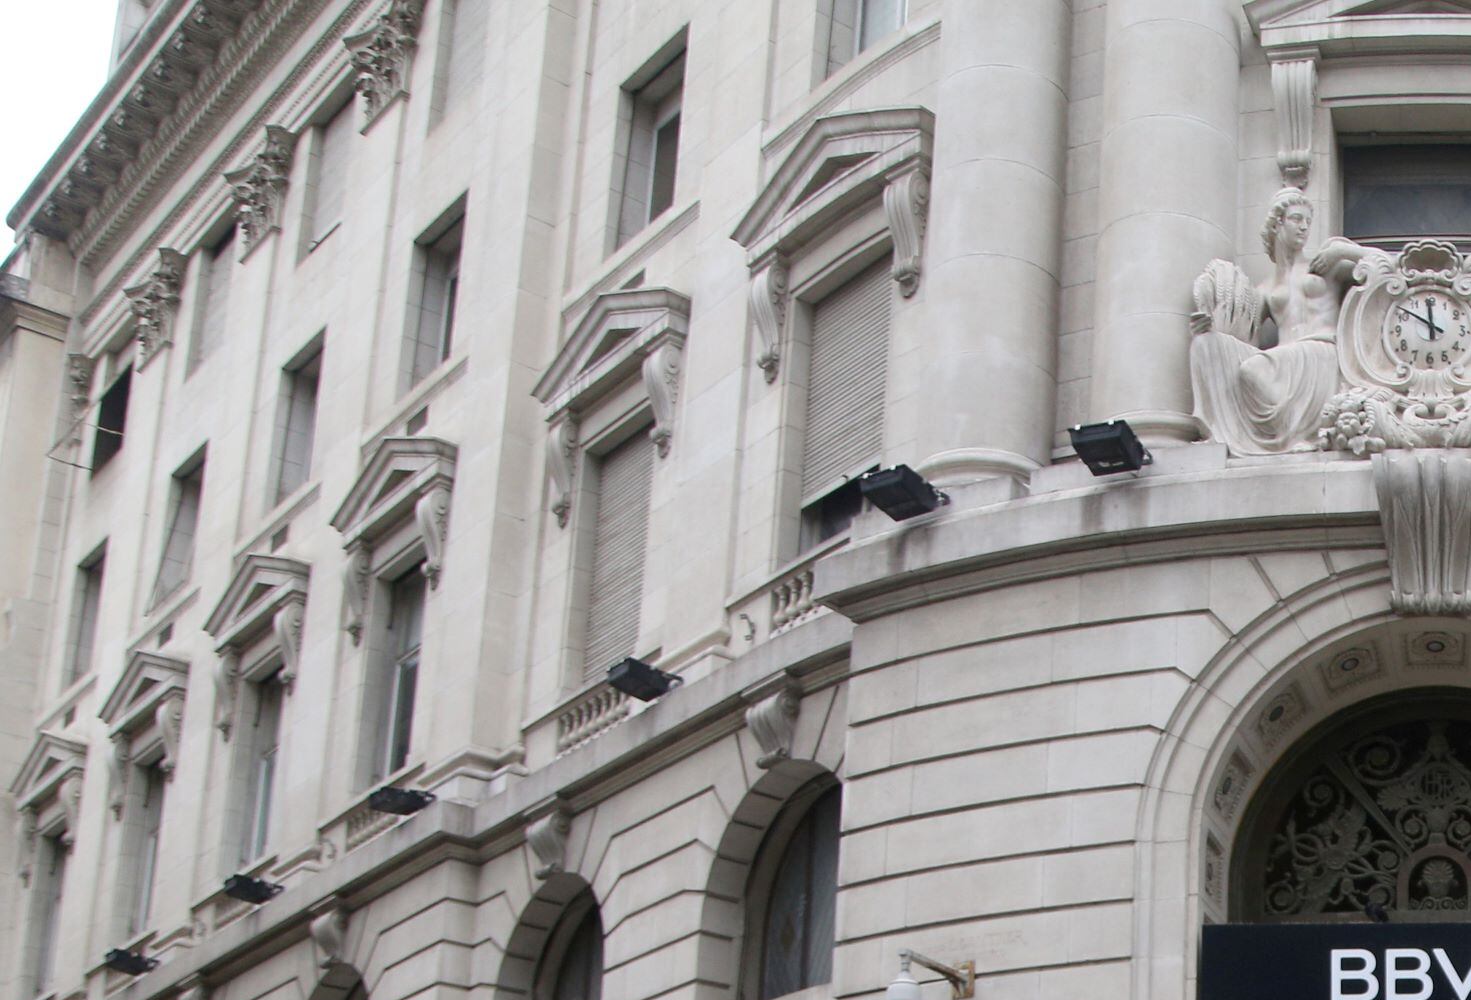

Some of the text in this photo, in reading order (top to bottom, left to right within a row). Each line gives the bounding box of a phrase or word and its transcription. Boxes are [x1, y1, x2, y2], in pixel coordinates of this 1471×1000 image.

[1453, 310, 1460, 320] 2
[1395, 325, 1402, 337] 9
[1459, 325, 1466, 337] 3
[1400, 339, 1408, 352] 8
[1452, 341, 1460, 351] 4
[1411, 350, 1419, 361] 7
[1426, 352, 1434, 364] 6
[1441, 351, 1448, 362] 5
